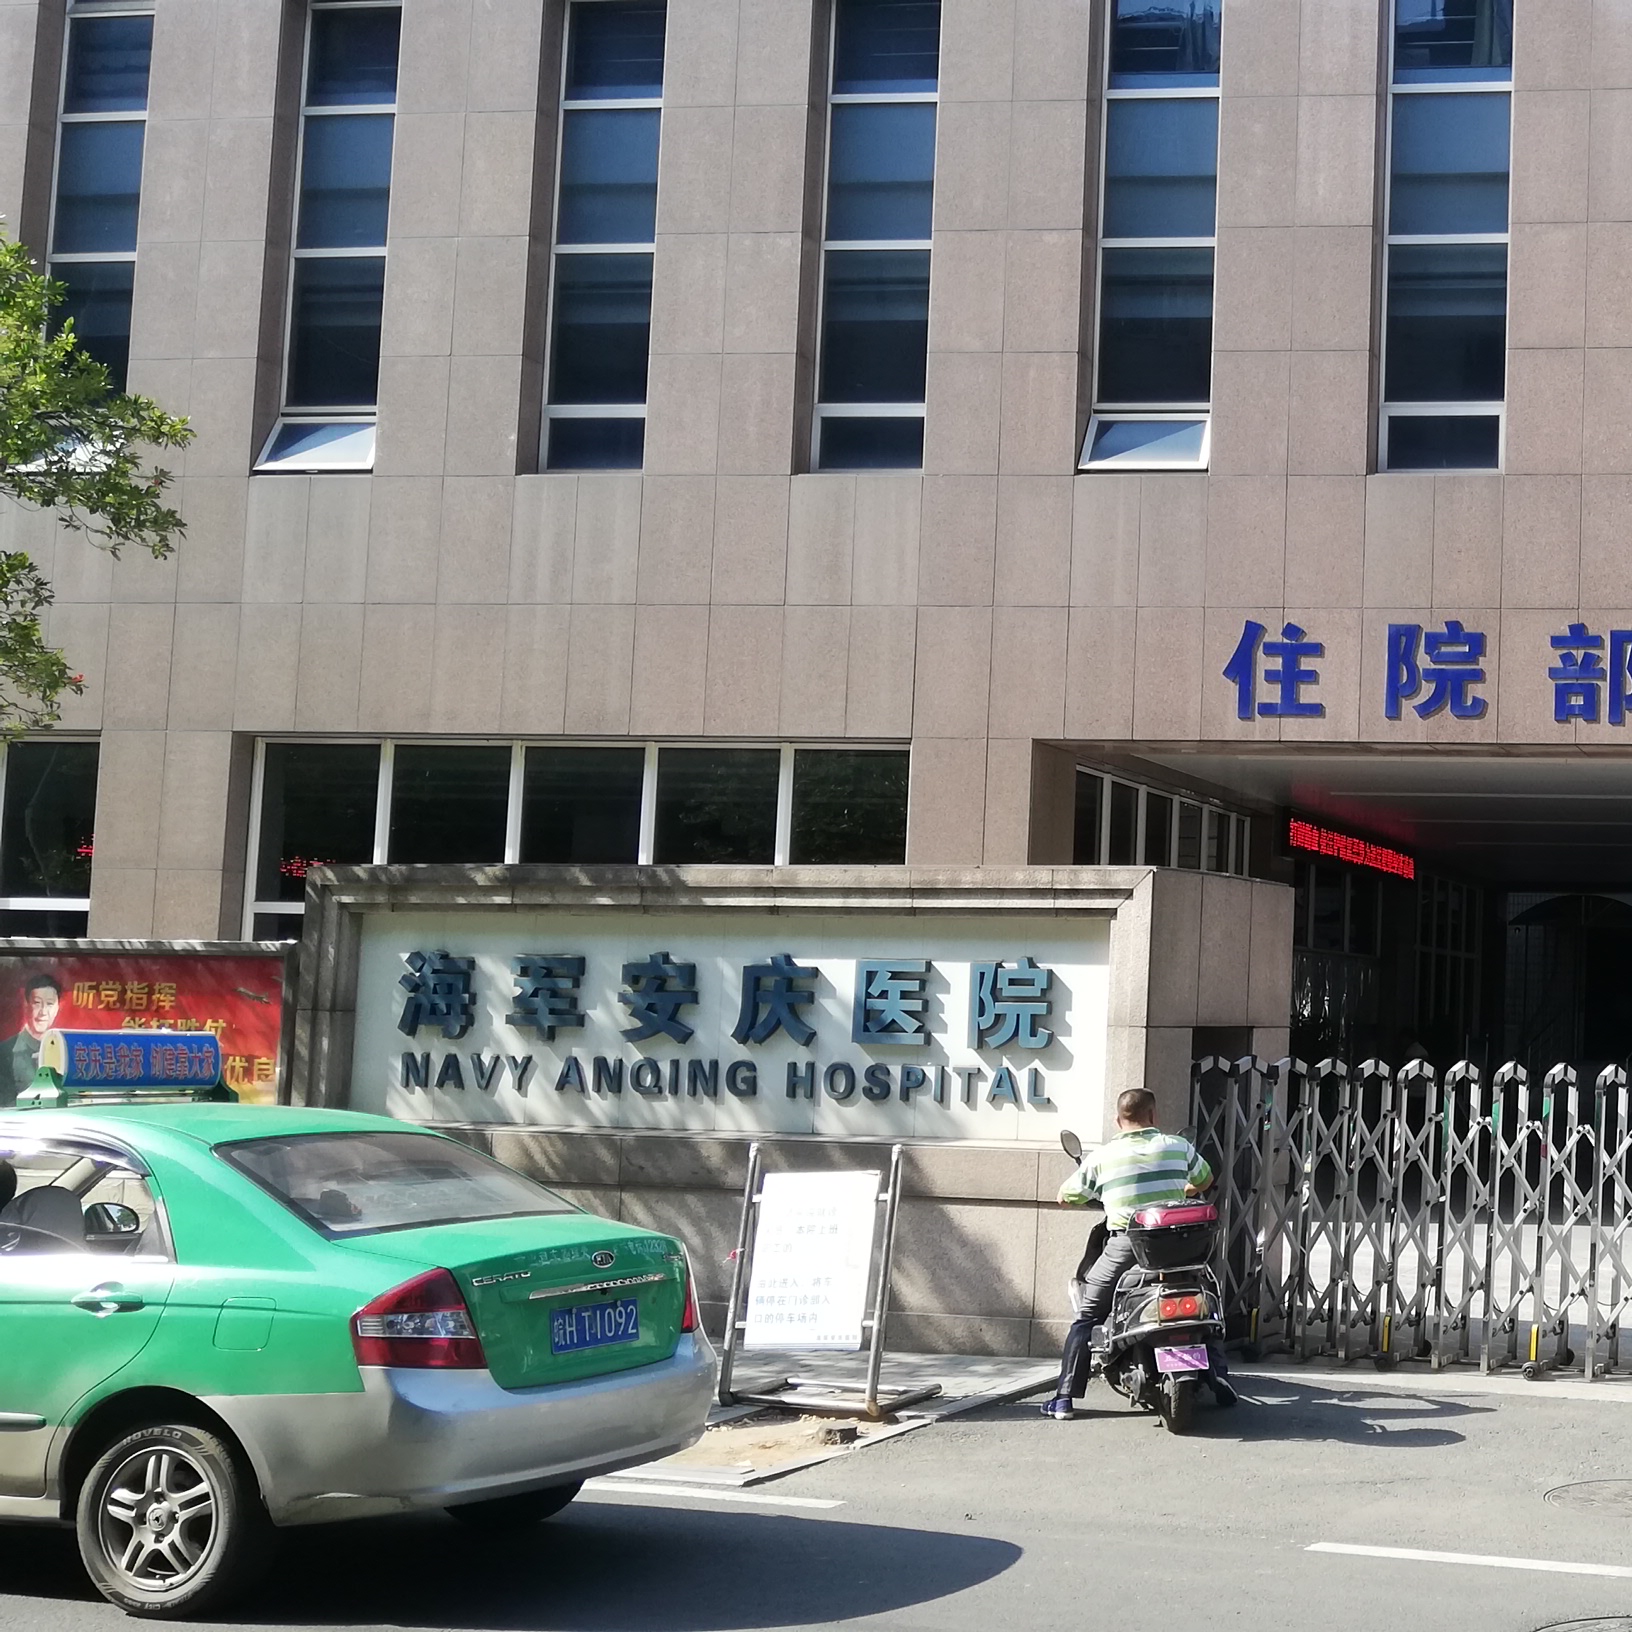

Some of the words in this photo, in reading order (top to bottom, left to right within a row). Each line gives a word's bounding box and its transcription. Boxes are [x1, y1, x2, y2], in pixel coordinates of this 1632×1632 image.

[72, 980, 177, 1011] 听党指挥
[398, 950, 1054, 1049] 海军安庆医院
[73, 1042, 144, 1082] 安庆是我家
[151, 1043, 216, 1082] 创建靠大家
[402, 1051, 533, 1093] NAVY
[555, 1054, 758, 1097] ANQING
[786, 1061, 1051, 1107] HOSPITAL
[472, 1271, 531, 1286] CERATO
